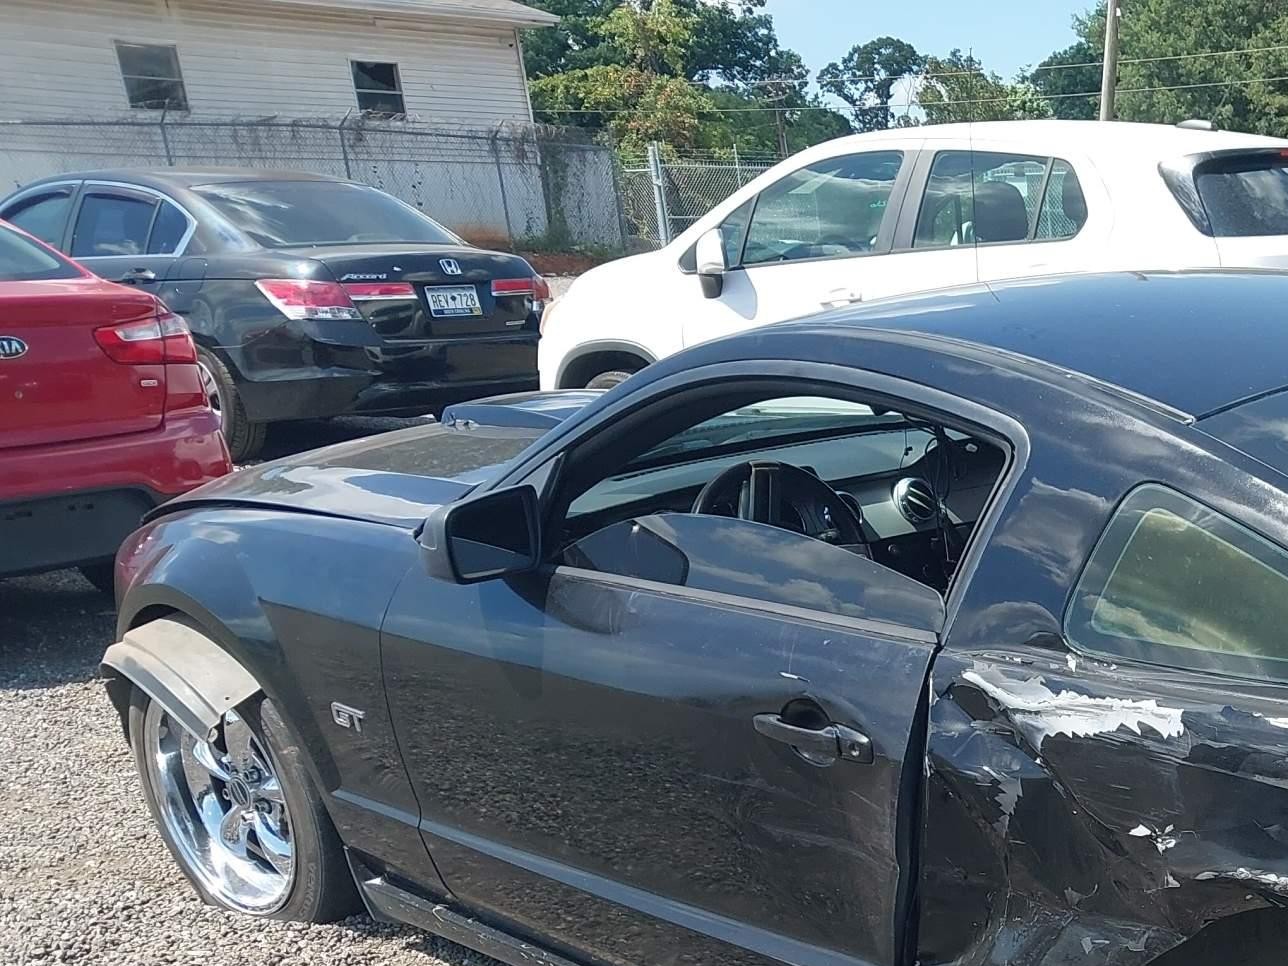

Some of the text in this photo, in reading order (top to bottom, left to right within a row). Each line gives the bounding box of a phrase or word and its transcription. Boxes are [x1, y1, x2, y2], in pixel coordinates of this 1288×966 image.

[340, 273, 387, 281] Accord
[430, 293, 477, 309] REV 728
[330, 701, 366, 733] GT
